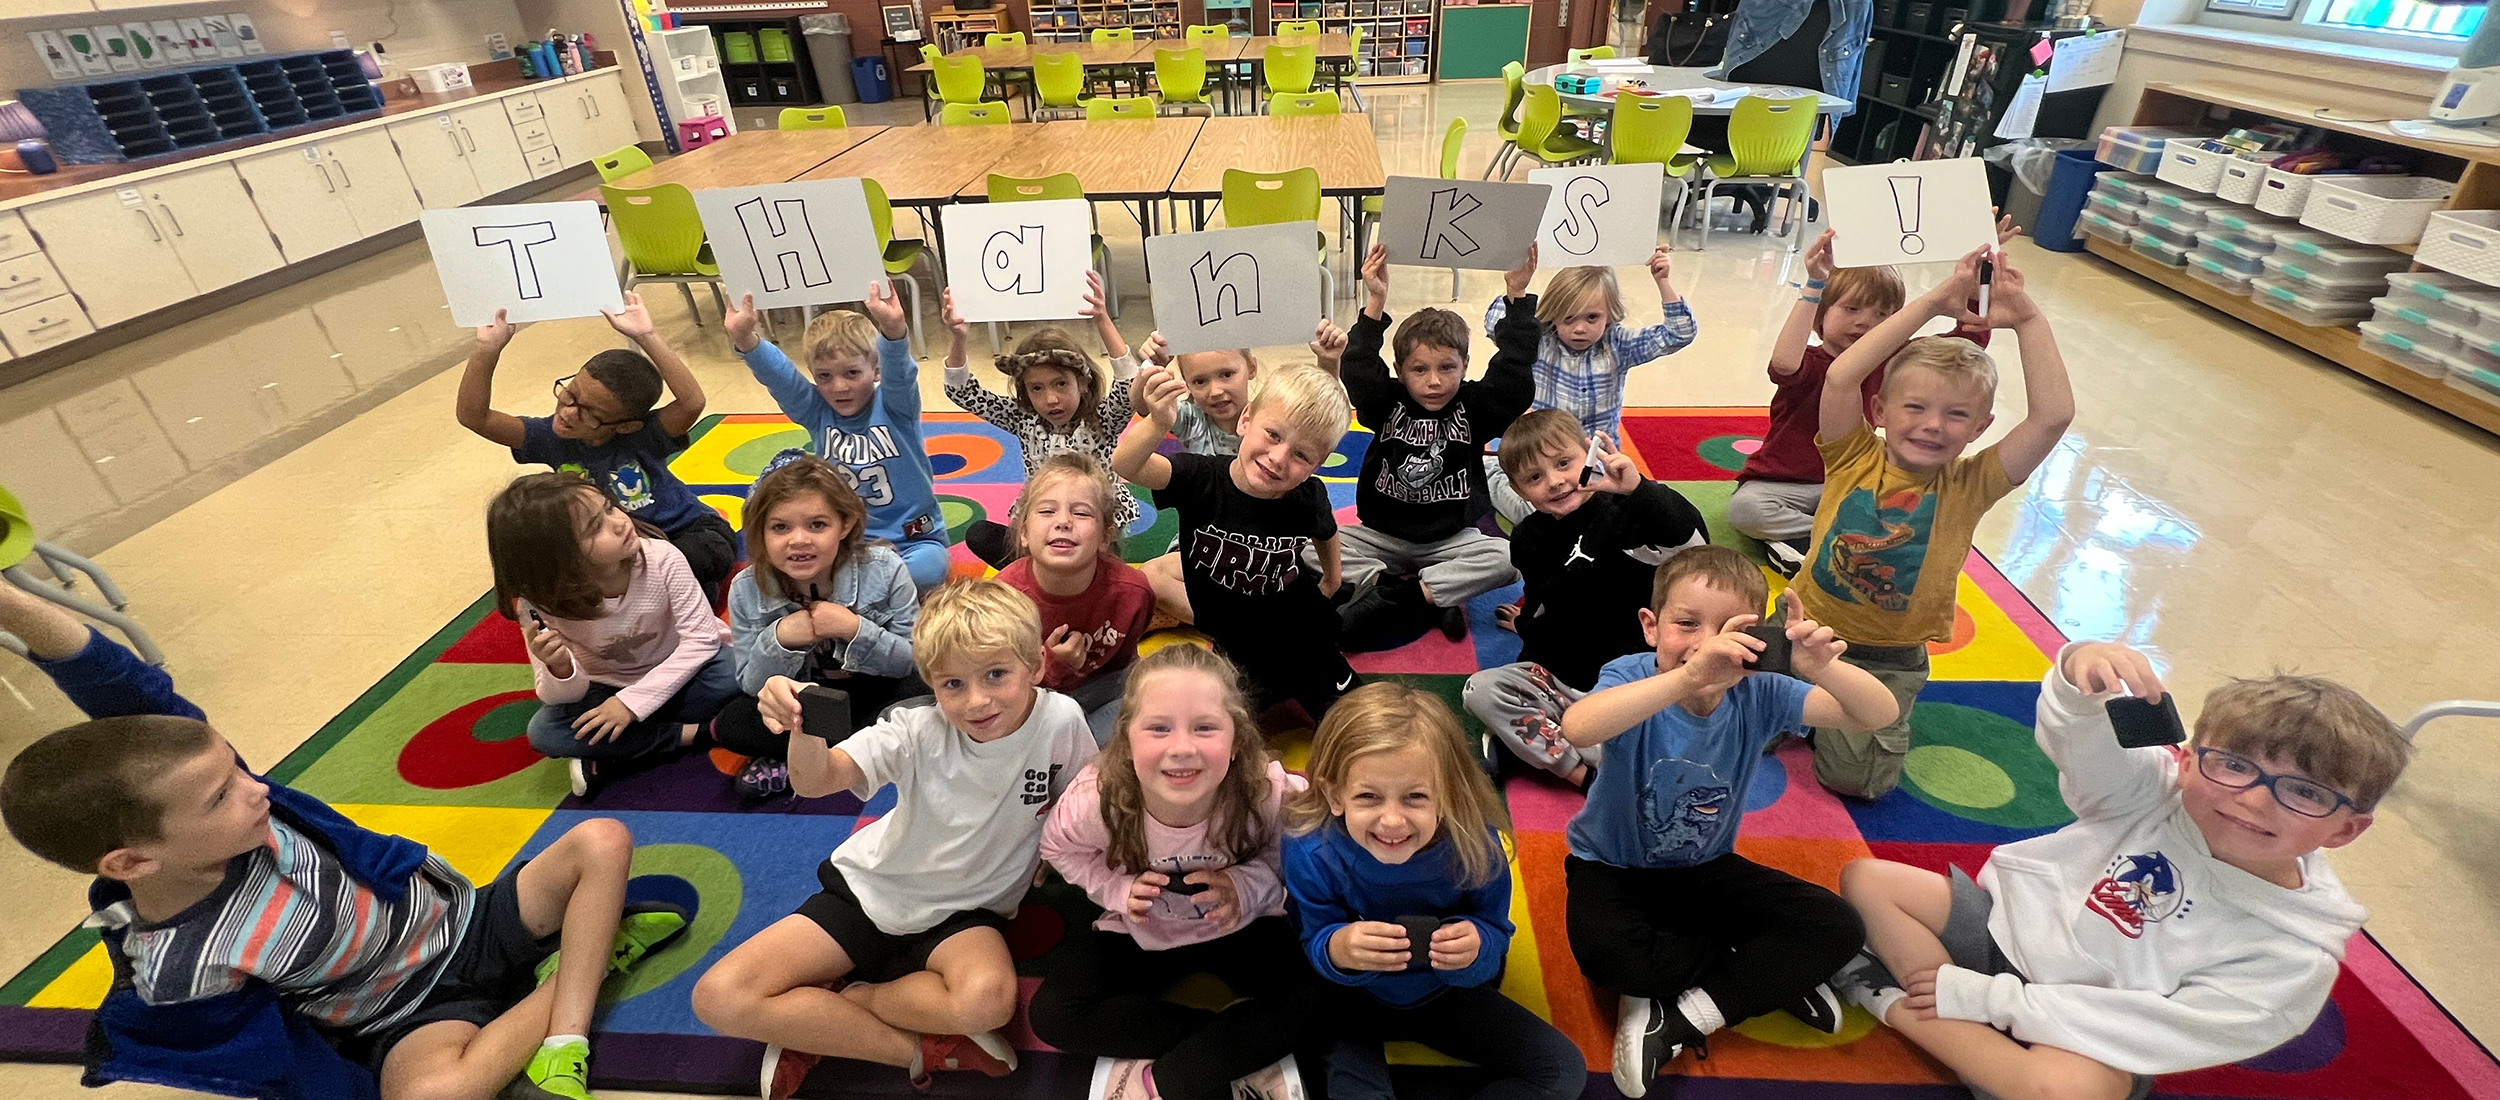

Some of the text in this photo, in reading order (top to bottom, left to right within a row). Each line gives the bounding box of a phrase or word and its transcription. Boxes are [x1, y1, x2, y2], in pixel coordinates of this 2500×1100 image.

[733, 195, 833, 293] H
[1886, 175, 1925, 256] !
[472, 219, 557, 301] T
[981, 224, 1045, 296] a
[1189, 250, 1262, 327] n
[824, 424, 900, 465] JORDAN
[1374, 457, 1472, 504] BASEBALL
[1024, 768, 1047, 782] Go
